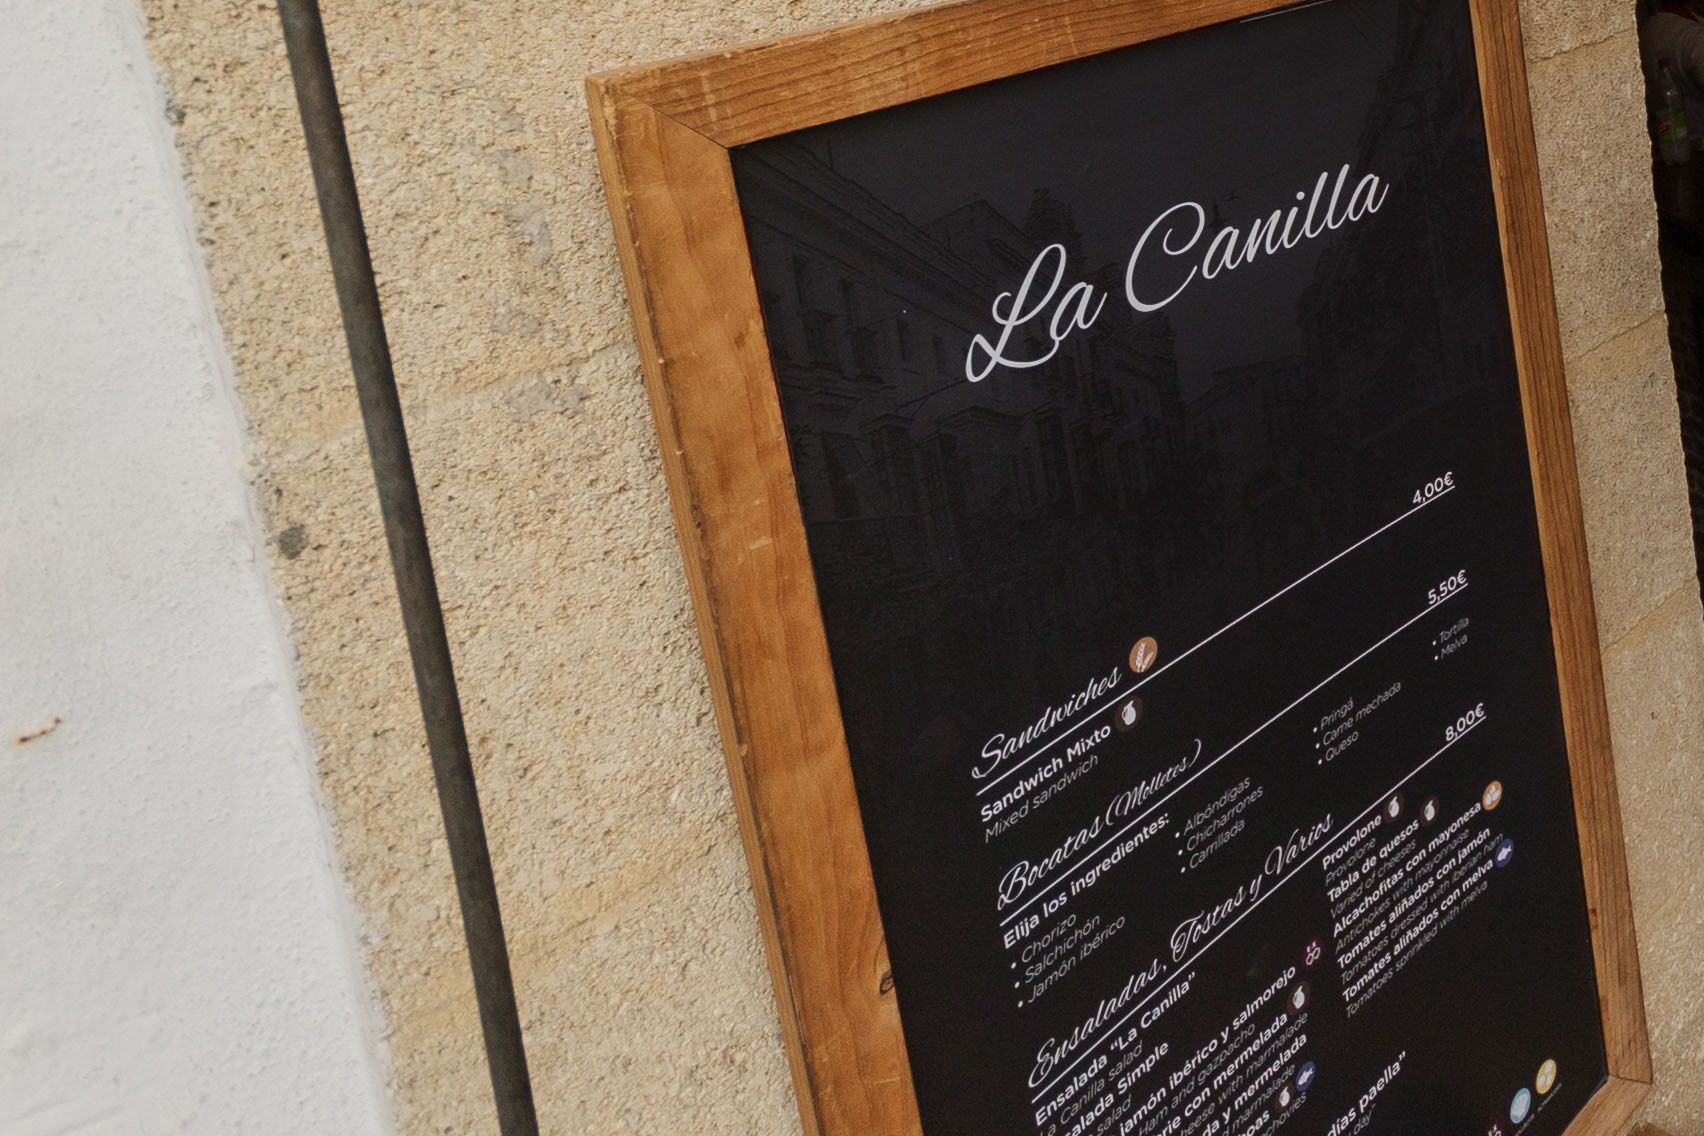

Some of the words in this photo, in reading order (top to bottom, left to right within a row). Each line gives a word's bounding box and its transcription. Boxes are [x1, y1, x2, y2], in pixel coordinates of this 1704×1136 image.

[965, 243, 1108, 383] La
[1125, 163, 1389, 313] Canilla
[971, 666, 1122, 779] Sandwiches
[1412, 471, 1454, 504] 4,00€
[996, 815, 1104, 911] Bocatas
[1104, 738, 1202, 827] (Molletes)
[1427, 569, 1467, 605] 5,50€
[1322, 716, 1354, 746] Carne
[1355, 681, 1401, 722] mechada
[1325, 731, 1359, 762] Queso
[980, 755, 1063, 822] Sandwich
[1066, 725, 1111, 762] Mixto
[985, 802, 1030, 844] Mixed
[1032, 754, 1098, 809] sandwich
[1183, 776, 1250, 837] Albóndigas
[1170, 886, 1248, 963] Tostas
[1249, 874, 1263, 902] y
[1264, 813, 1334, 876] Varios
[1445, 702, 1485, 741] 8,00€
[1186, 786, 1264, 852] Chicharrones
[1322, 815, 1382, 870] Provolone
[1325, 837, 1376, 886] Provolone
[1327, 870, 1360, 902] Tabla
[1361, 855, 1377, 874] de
[1379, 819, 1420, 858] quesos
[1003, 914, 1040, 950] Elija
[1042, 891, 1068, 918] los
[1070, 813, 1169, 897] ingredientes:
[1334, 868, 1404, 938] Alcachofitas
[1405, 848, 1427, 872] con
[1428, 802, 1482, 853] mayonesa
[1337, 919, 1387, 969] Tomates
[1388, 876, 1435, 924] aliñados
[1436, 858, 1457, 880] con
[1457, 827, 1491, 864] jamón
[1021, 914, 1077, 963] Chorizo
[1024, 915, 1100, 984] Salchichón
[1027, 956, 1077, 1003] Jamón
[1079, 916, 1126, 960] ibérico
[1342, 952, 1392, 1002] Tomates
[1393, 907, 1440, 956] aliñados
[1440, 888, 1461, 911] con
[1461, 859, 1494, 892] melva
[1169, 1039, 1218, 1090] ibérico
[1220, 1026, 1229, 1044] y
[1232, 966, 1296, 1030] salmorejo
[1345, 967, 1394, 1019] Tomatoes
[1035, 1055, 1107, 1127] Ensalada
[1060, 1078, 1105, 1125] Canilla
[1108, 1039, 1143, 1082] salad
[1117, 1042, 1169, 1095] Simple
[1171, 1076, 1195, 1109] and
[1197, 1024, 1256, 1086] gazpacho
[1184, 1087, 1211, 1117] con
[1213, 1013, 1288, 1090] mermelada
[1222, 1106, 1231, 1124] y
[1234, 1034, 1307, 1110] mermelada
